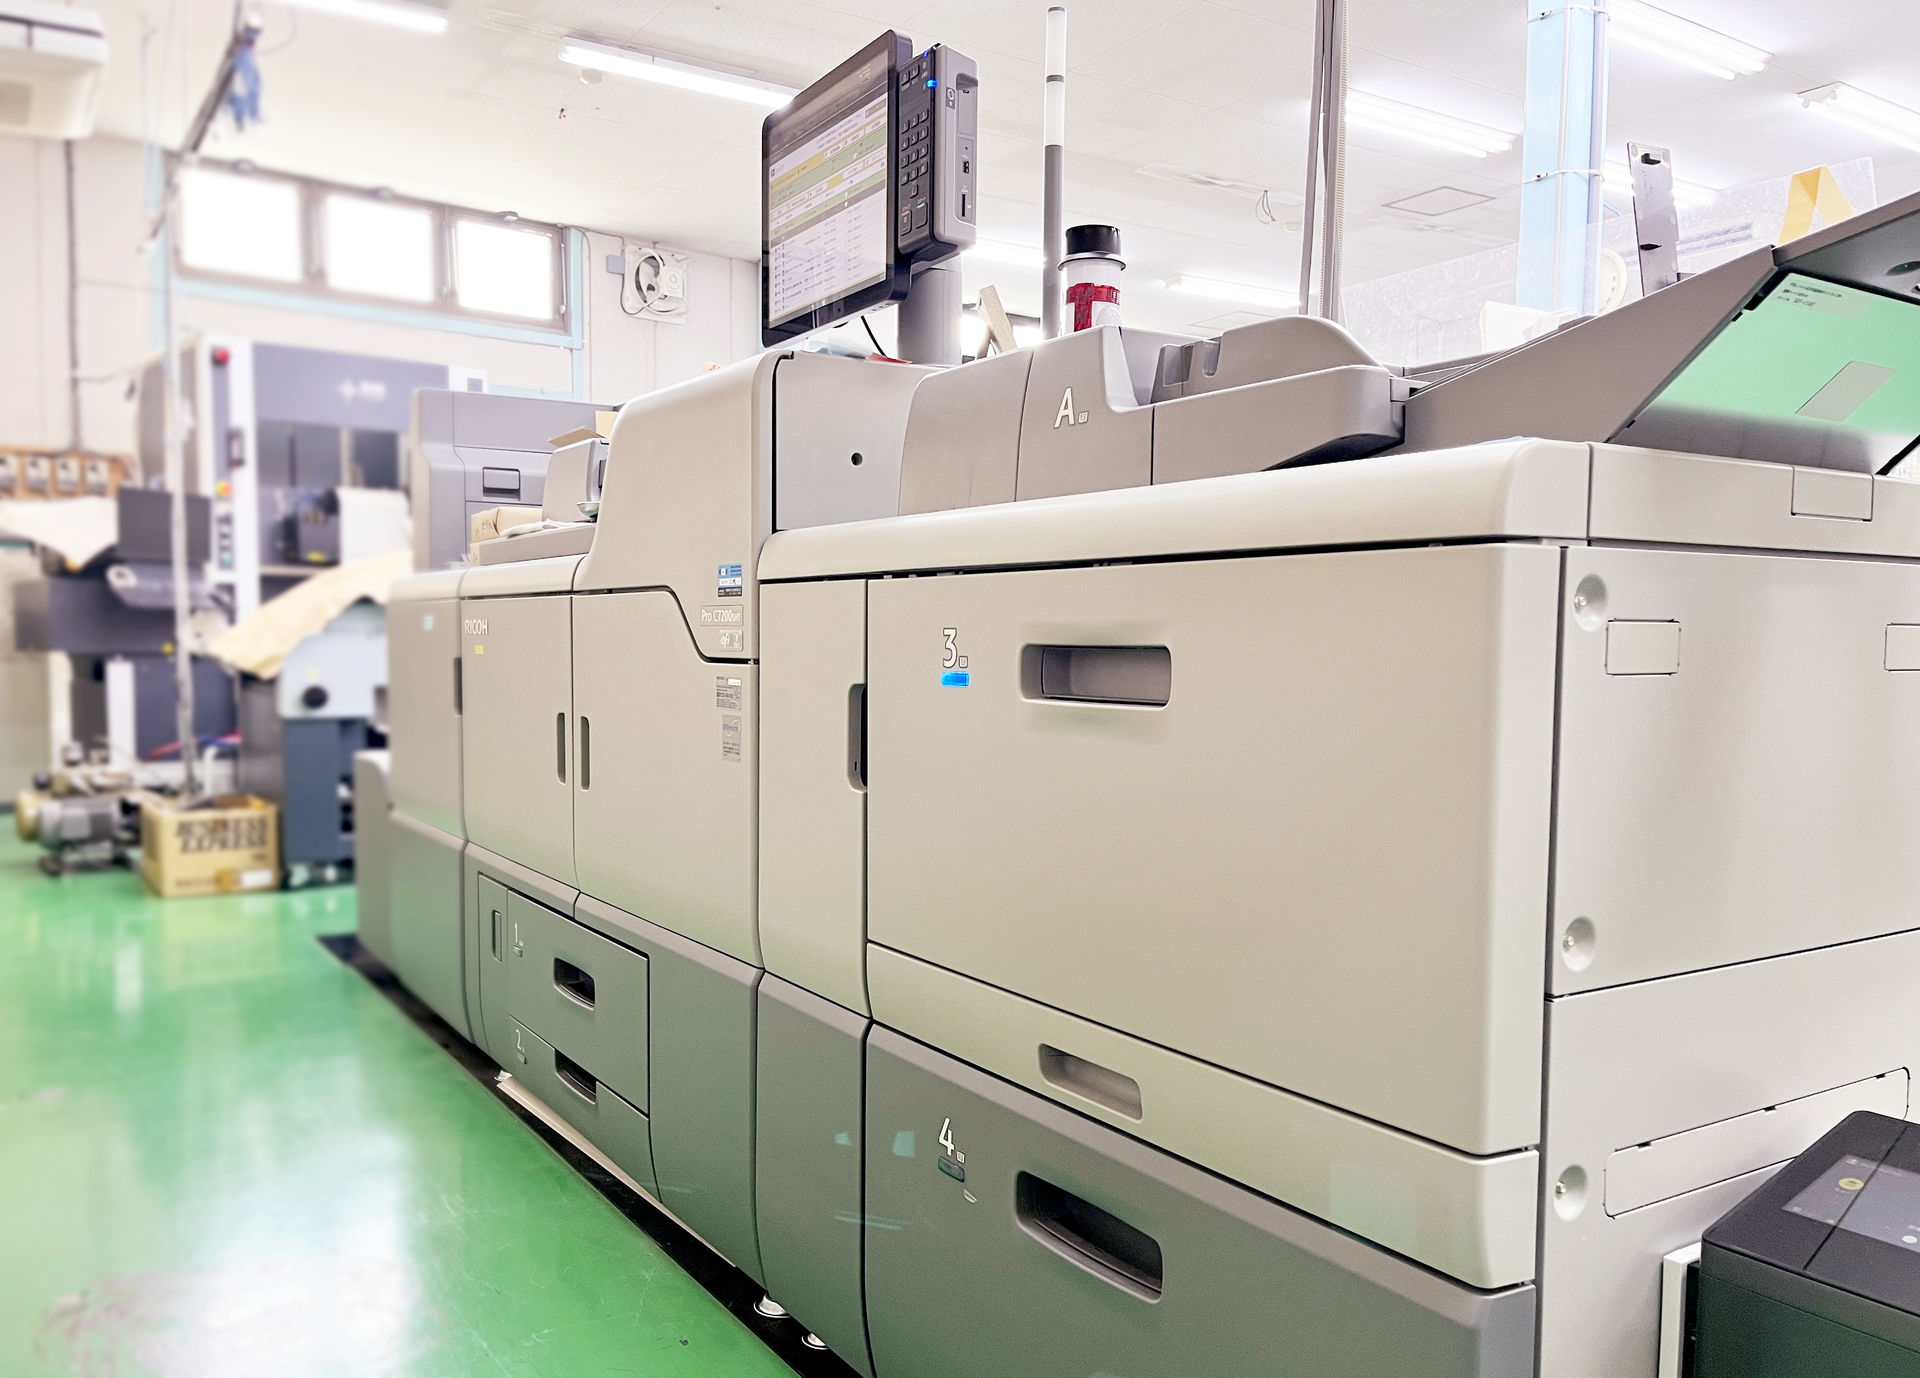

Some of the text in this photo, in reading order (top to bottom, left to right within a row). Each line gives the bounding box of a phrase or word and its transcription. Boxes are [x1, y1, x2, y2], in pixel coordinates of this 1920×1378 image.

[1053, 387, 1075, 428] A
[464, 619, 488, 635] RICOH
[701, 610, 712, 622] Pro
[943, 628, 957, 668] 3
[938, 1116, 955, 1156] 4
